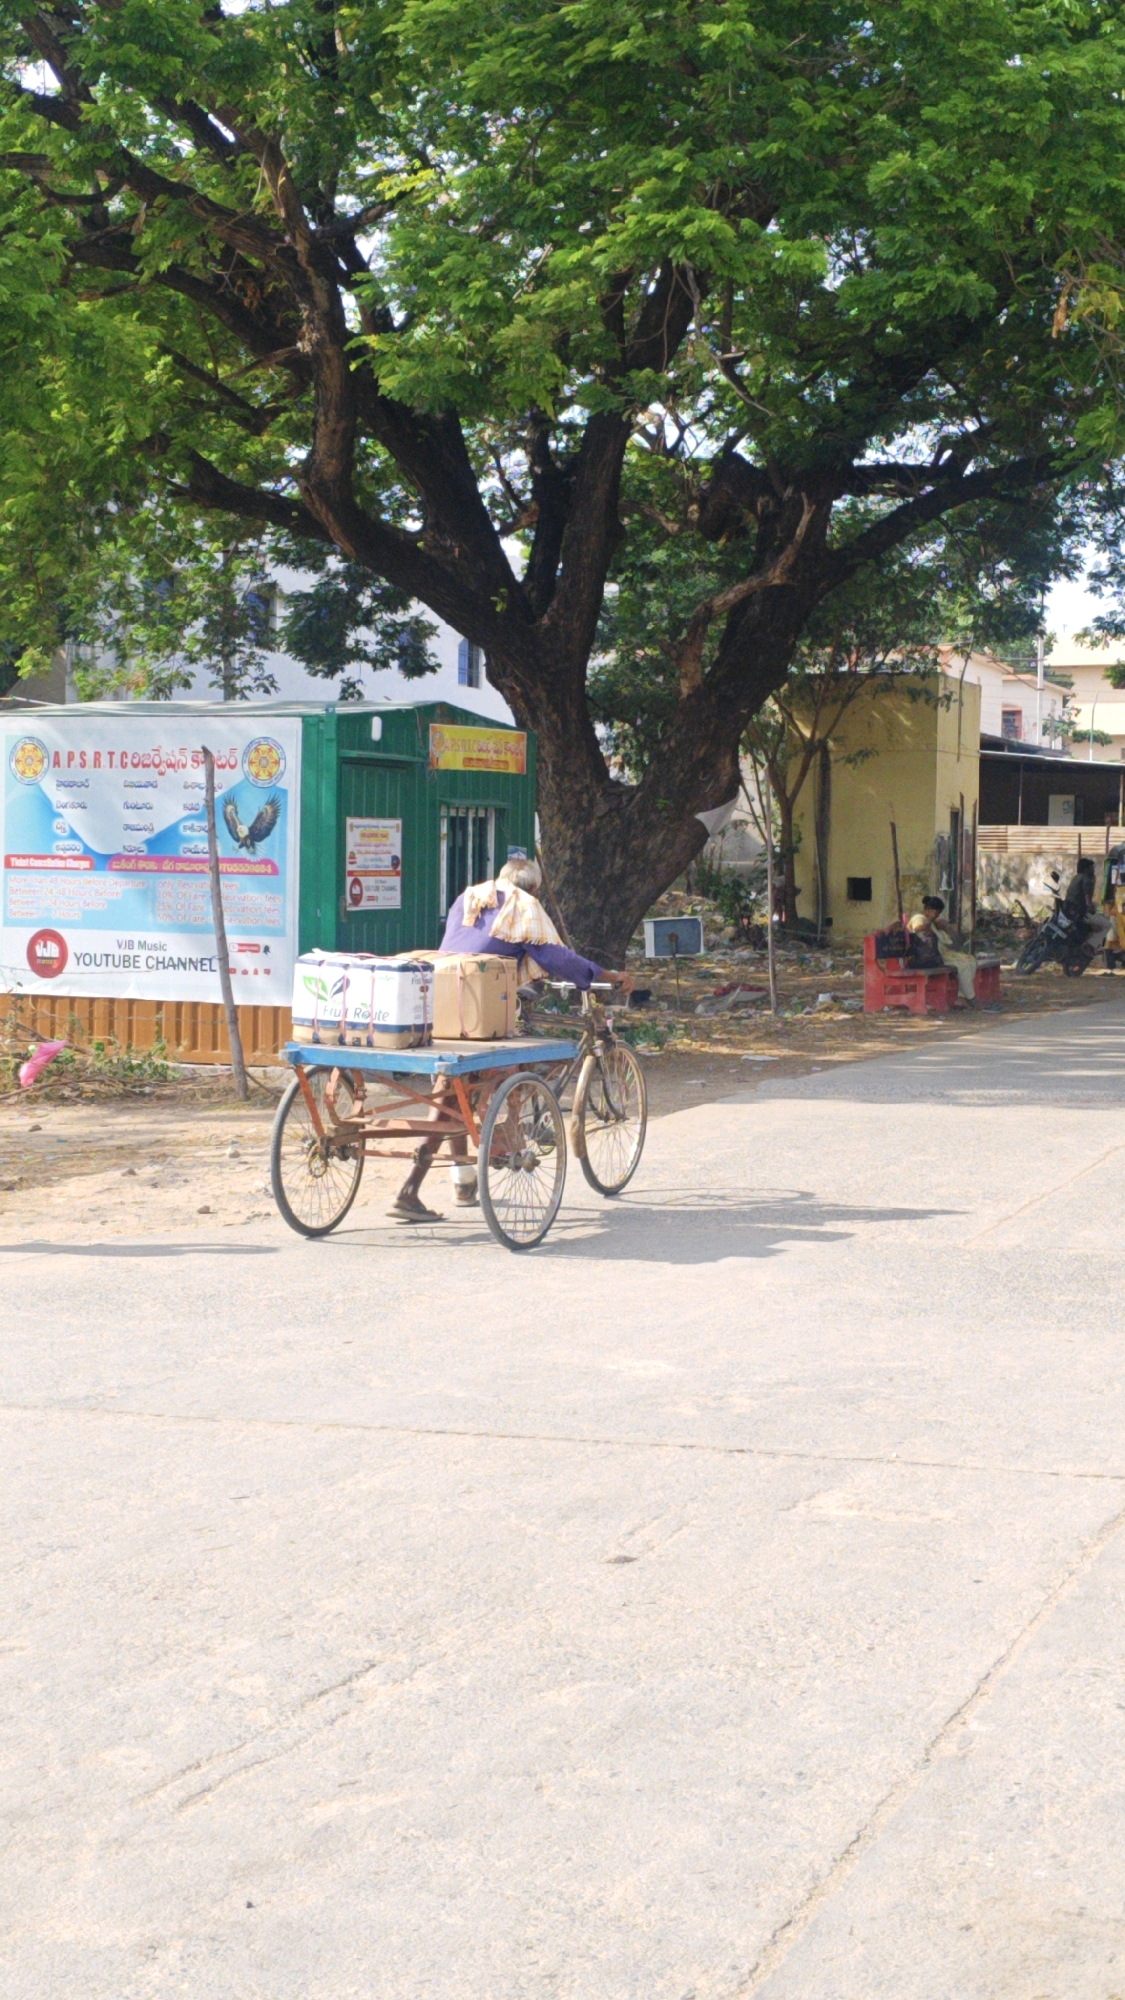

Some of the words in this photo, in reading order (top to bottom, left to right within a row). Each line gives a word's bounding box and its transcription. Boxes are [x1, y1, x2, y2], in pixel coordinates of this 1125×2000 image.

[9, 876, 29, 885] More
[60, 877, 82, 886] Hours
[83, 878, 107, 887] Before
[109, 878, 147, 889] Departure
[178, 881, 211, 890] Resrvati
[9, 886, 42, 896] Between
[68, 888, 93, 898] Hours
[94, 889, 121, 898] Before
[176, 892, 187, 900] Of
[189, 892, 206, 901] Fare
[265, 894, 282, 903] fees
[9, 897, 39, 907] Between
[59, 898, 81, 908] Hours
[82, 899, 107, 909] Before
[175, 902, 186, 911] Of
[188, 903, 205, 912] Fare
[9, 908, 39, 918] Between
[59, 909, 81, 919] Hours
[176, 913, 186, 922] Of
[188, 914, 205, 923] Fare
[116, 939, 135, 950] VJB
[137, 940, 168, 952] Music
[73, 952, 141, 969] YOUTUBE
[145, 955, 217, 973] CHANNEL
[323, 1005, 349, 1019] Frut
